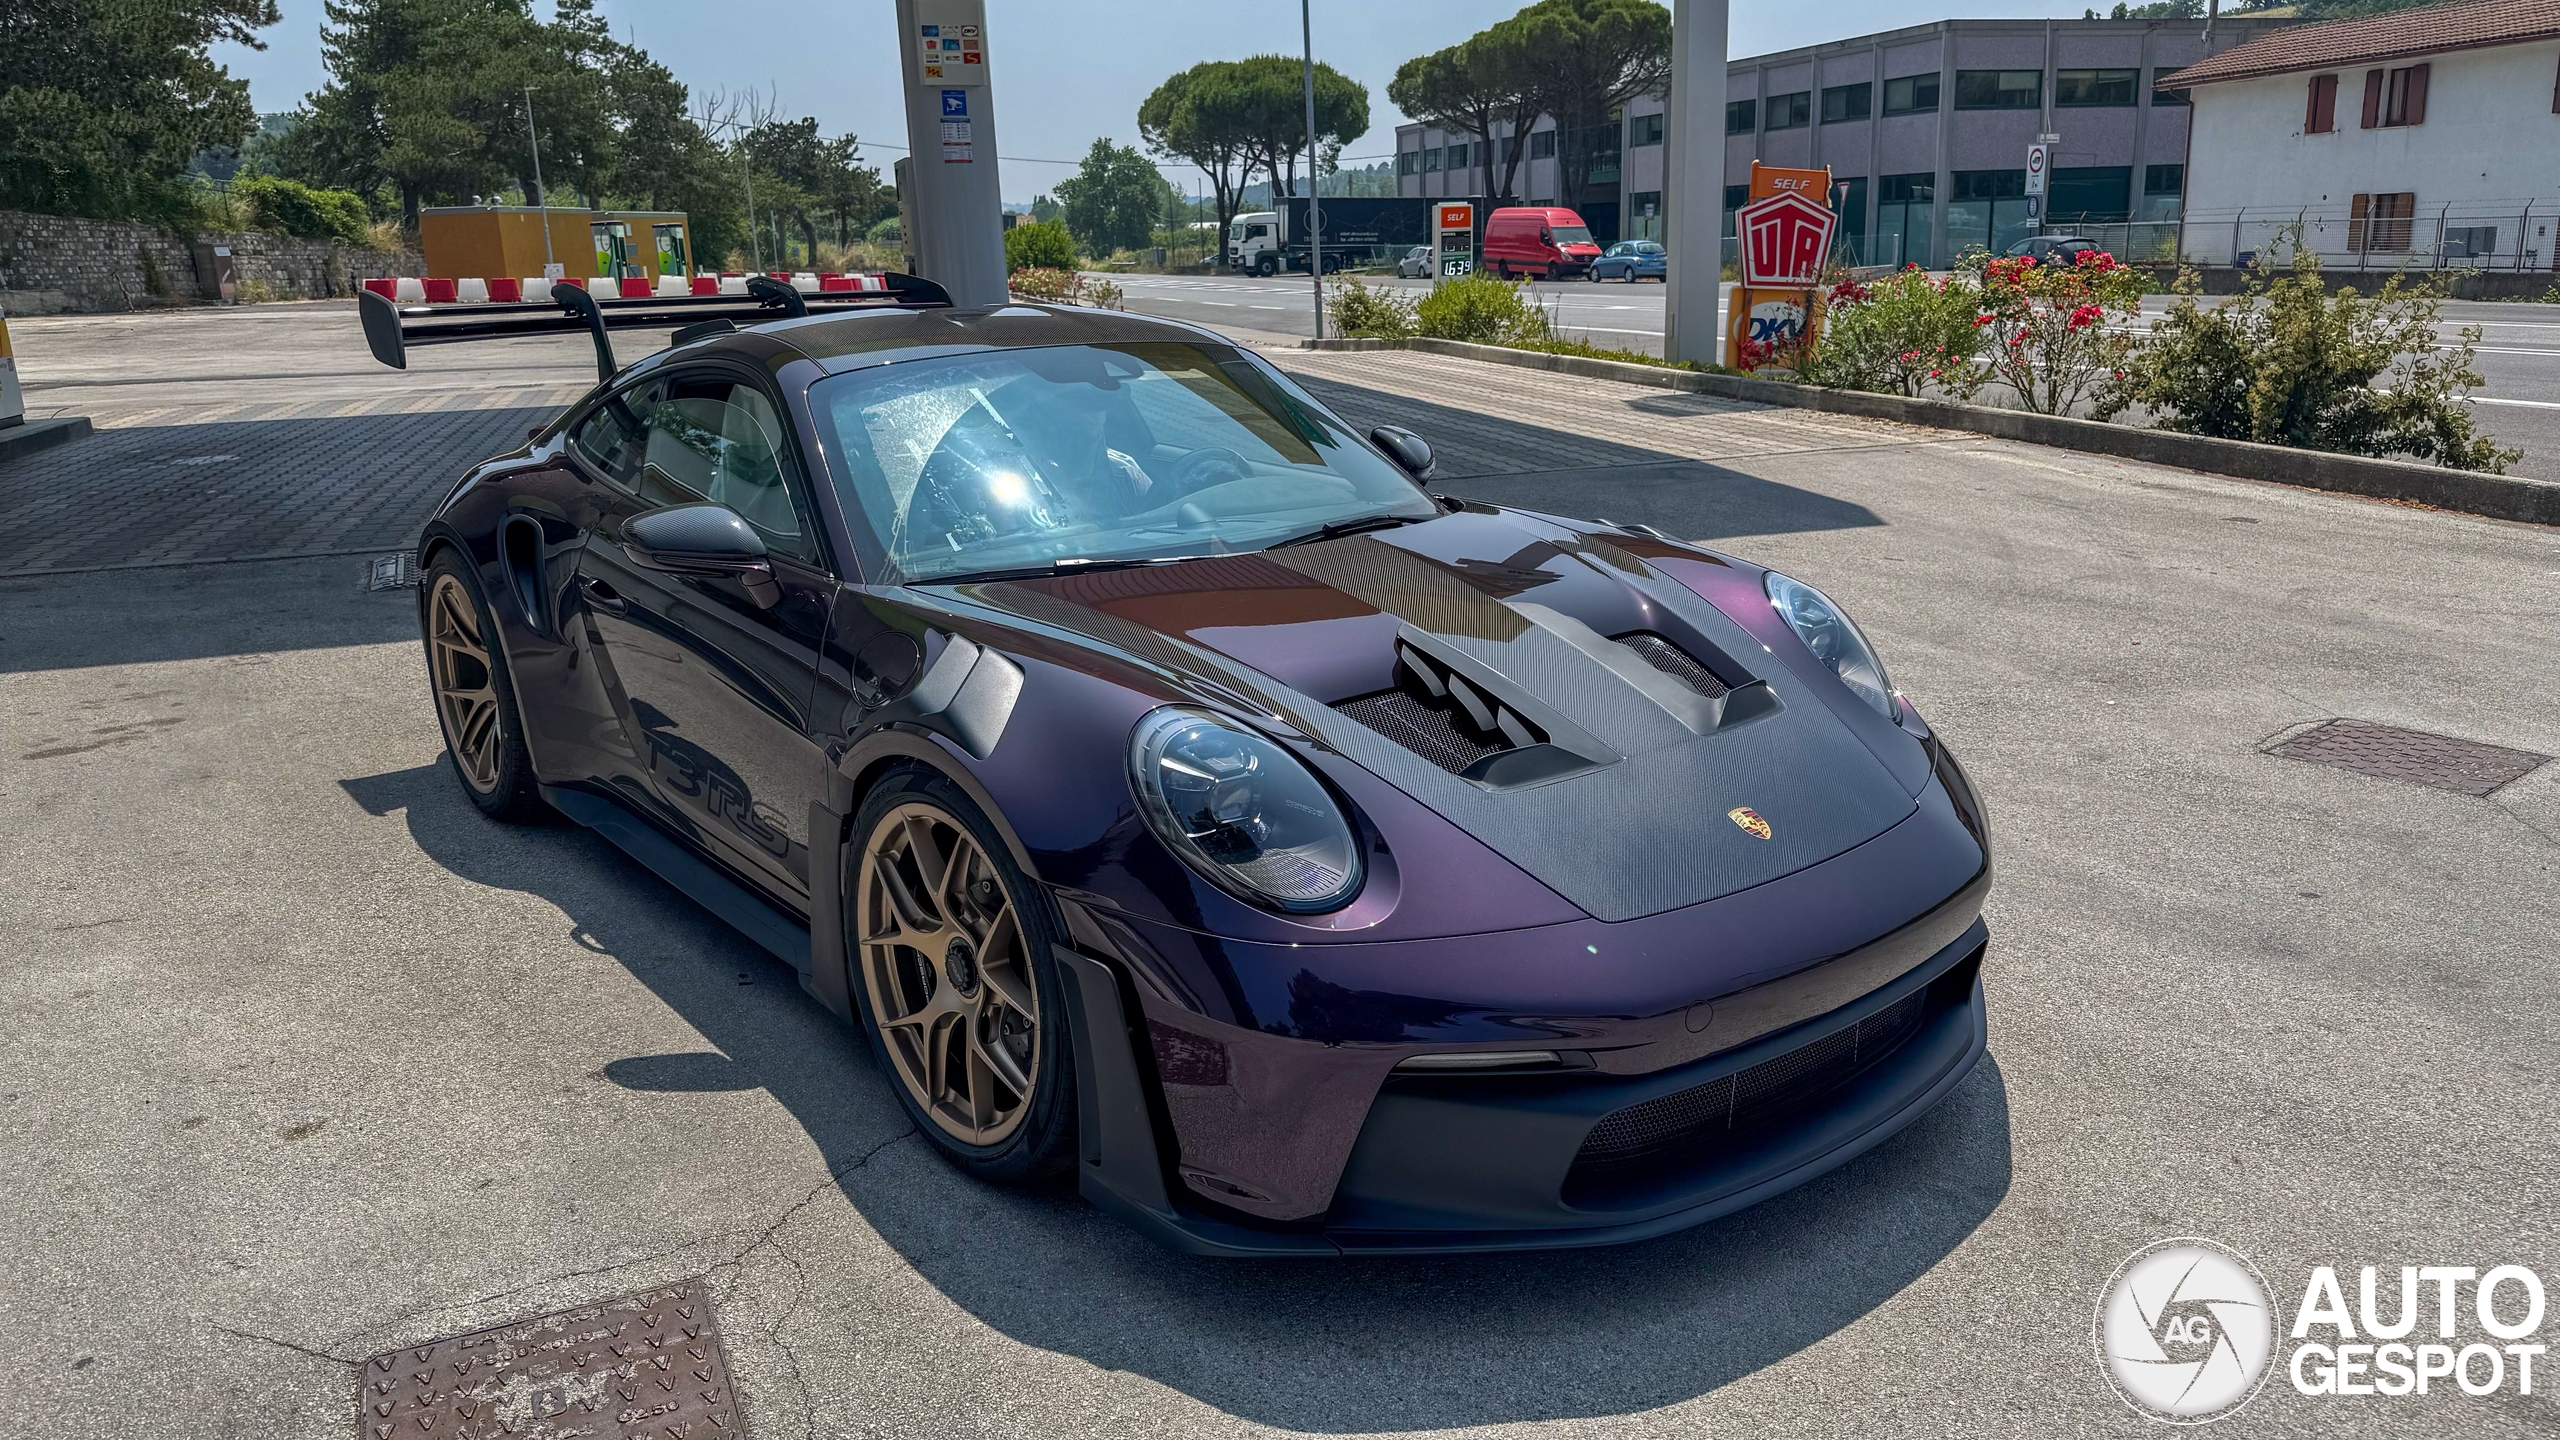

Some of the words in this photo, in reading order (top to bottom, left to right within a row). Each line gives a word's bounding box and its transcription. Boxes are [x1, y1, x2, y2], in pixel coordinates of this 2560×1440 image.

[1773, 178, 1812, 190] SELF
[1447, 213, 1465, 221] SELF
[1751, 205, 1825, 277] UTA
[1748, 317, 1808, 341] DKV
